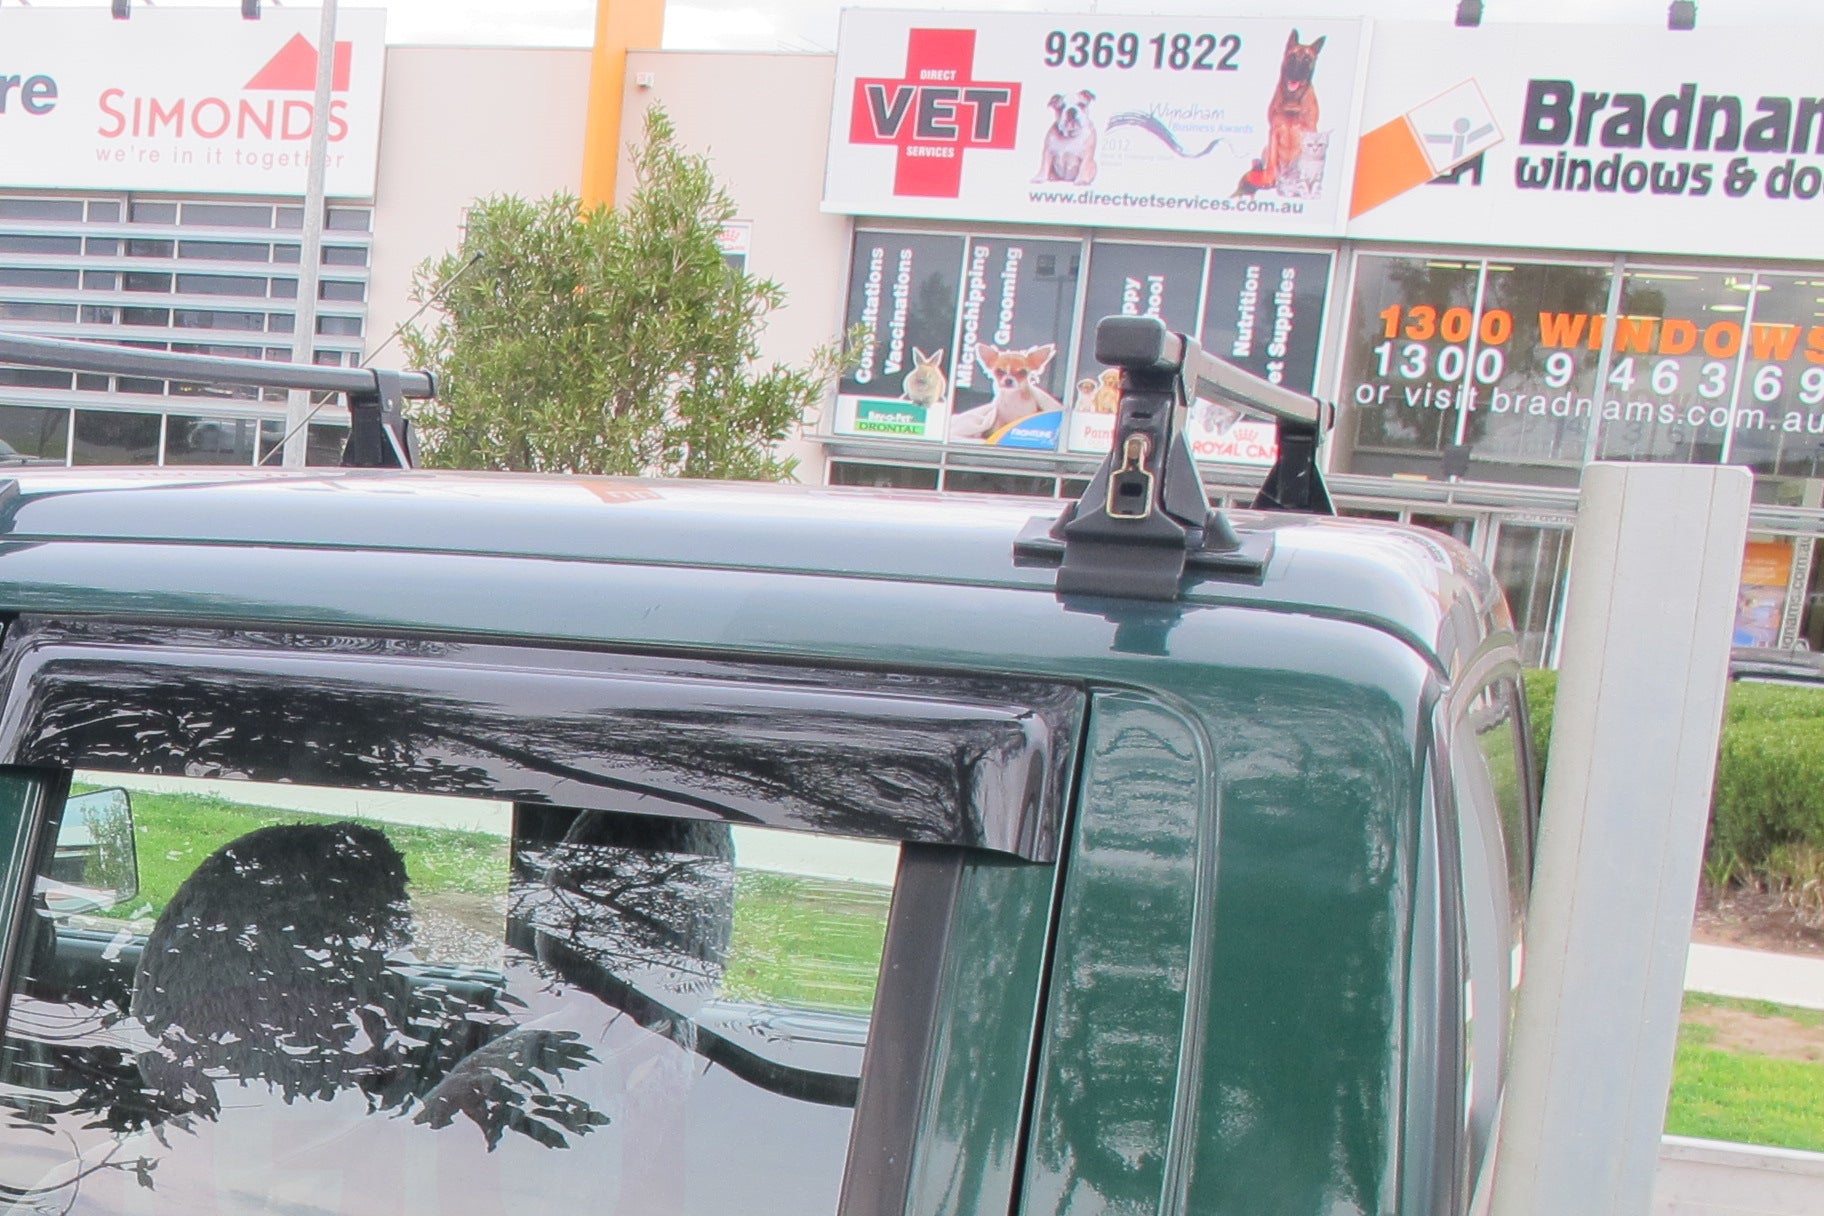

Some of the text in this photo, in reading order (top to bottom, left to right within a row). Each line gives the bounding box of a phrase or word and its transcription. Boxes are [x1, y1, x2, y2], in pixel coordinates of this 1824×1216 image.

[1044, 31, 1242, 71] 9369 1822
[920, 69, 957, 81] DIRECT
[98, 88, 348, 142] SIMONDS
[864, 84, 1011, 142] VET
[1149, 102, 1225, 121] Wyndham
[1218, 123, 1254, 133] Awards
[96, 146, 160, 164] we're
[173, 147, 193, 164] in
[206, 147, 222, 165] it
[906, 146, 955, 158] SERVICES
[1515, 152, 1713, 196] windows
[1724, 157, 1757, 197] &
[1766, 159, 1824, 200] do
[1029, 189, 1304, 214] www.directvetservices.com.au
[884, 248, 913, 375] Vaccinations
[955, 245, 990, 388] Microchipping
[993, 247, 1023, 345] Grooming
[1122, 277, 1143, 316] ppy
[1232, 265, 1262, 357] Nutrition
[1267, 267, 1296, 384] et Supplies
[1380, 304, 1515, 345] 1300
[1374, 341, 1506, 384] 1300
[859, 421, 919, 434] DRONTAL
[1355, 383, 1390, 405] or
[1404, 382, 1479, 412] visit
[1491, 387, 1824, 434] bradnams.com.au
[1192, 440, 1281, 458] ROYAL CAN
